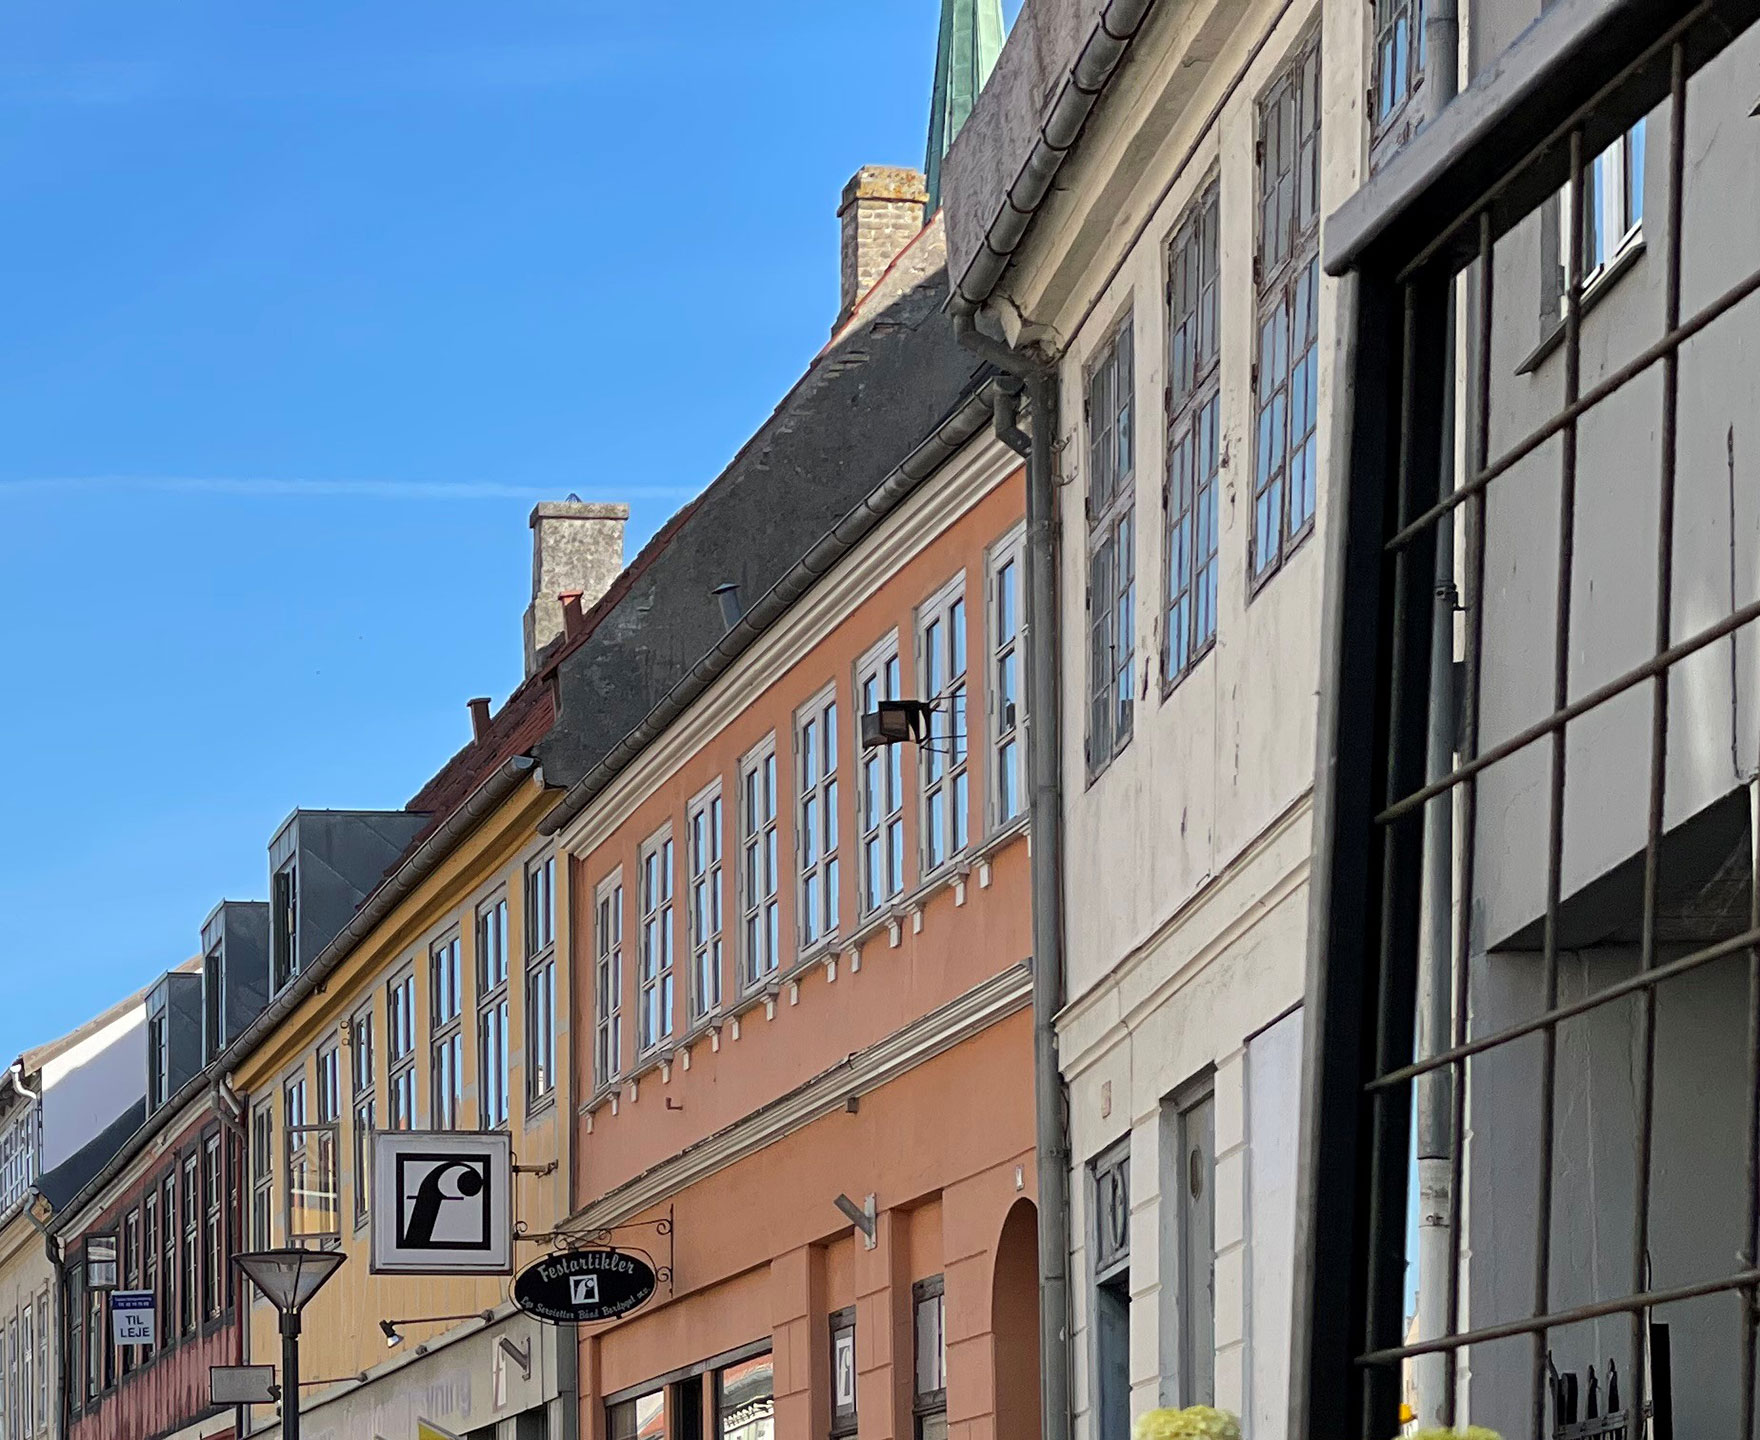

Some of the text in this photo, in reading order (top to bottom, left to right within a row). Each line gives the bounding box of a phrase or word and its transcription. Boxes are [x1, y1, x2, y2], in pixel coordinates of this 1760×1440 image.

[538, 1253, 635, 1282] Festartikler
[125, 1315, 144, 1326] TIL
[120, 1327, 150, 1338] LEJE
